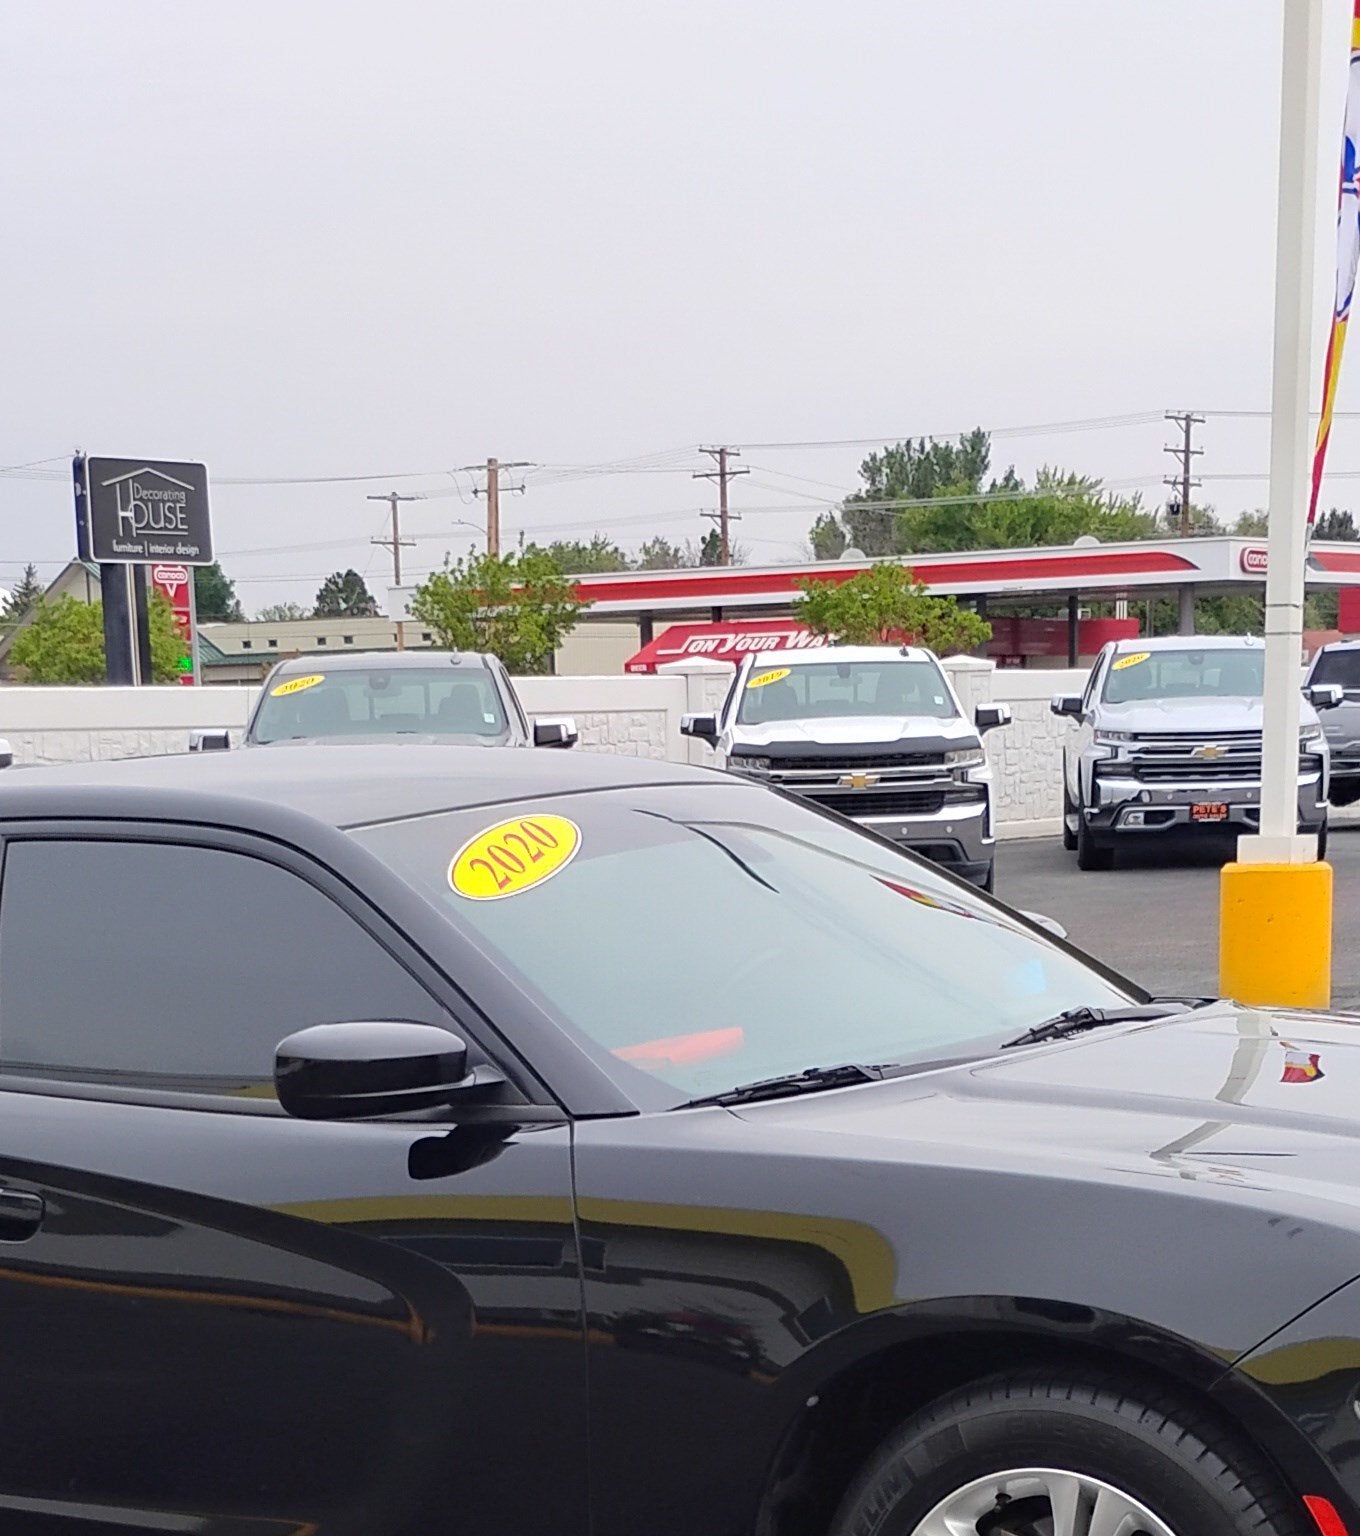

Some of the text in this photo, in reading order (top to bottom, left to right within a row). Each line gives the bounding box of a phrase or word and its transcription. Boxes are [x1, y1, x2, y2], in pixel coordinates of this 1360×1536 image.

[133, 482, 186, 503] Decorating
[112, 540, 144, 554] furniture
[149, 543, 174, 554] interior
[176, 543, 200, 557] design
[689, 640, 718, 653] ON
[718, 633, 781, 654] YOUR
[470, 821, 558, 889] 2020
